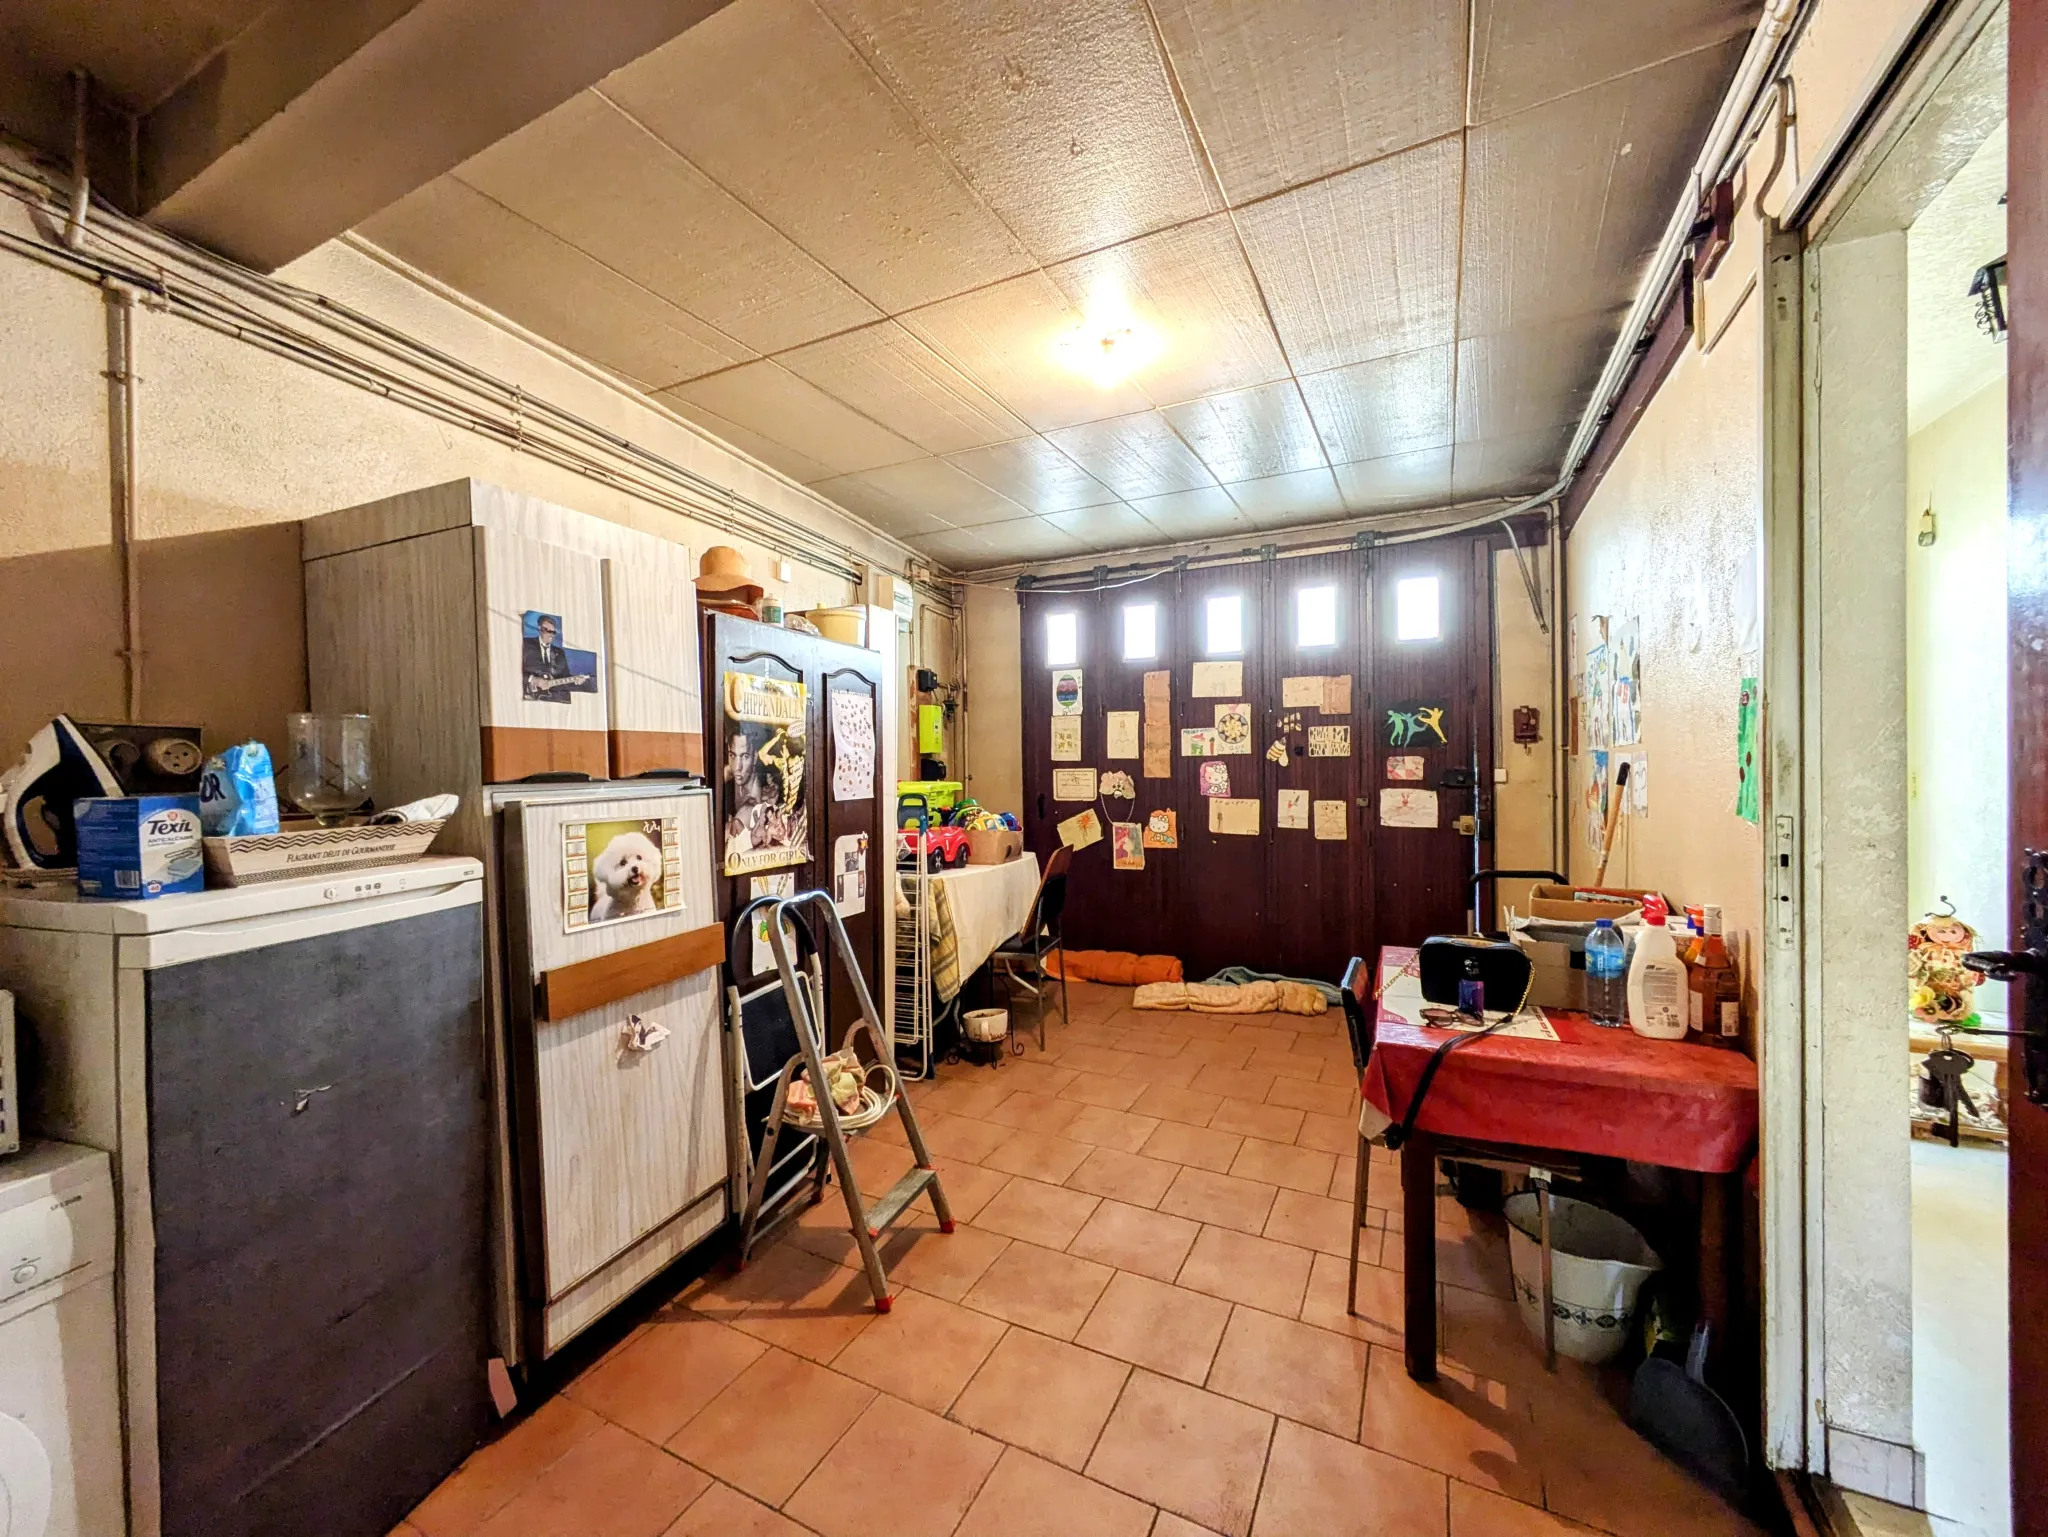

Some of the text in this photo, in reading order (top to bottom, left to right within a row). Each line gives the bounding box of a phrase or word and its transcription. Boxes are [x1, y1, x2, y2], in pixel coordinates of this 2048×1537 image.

[286, 852, 322, 863] FLAGRANT
[728, 848, 806, 869] ONLY FOR GIRLS
